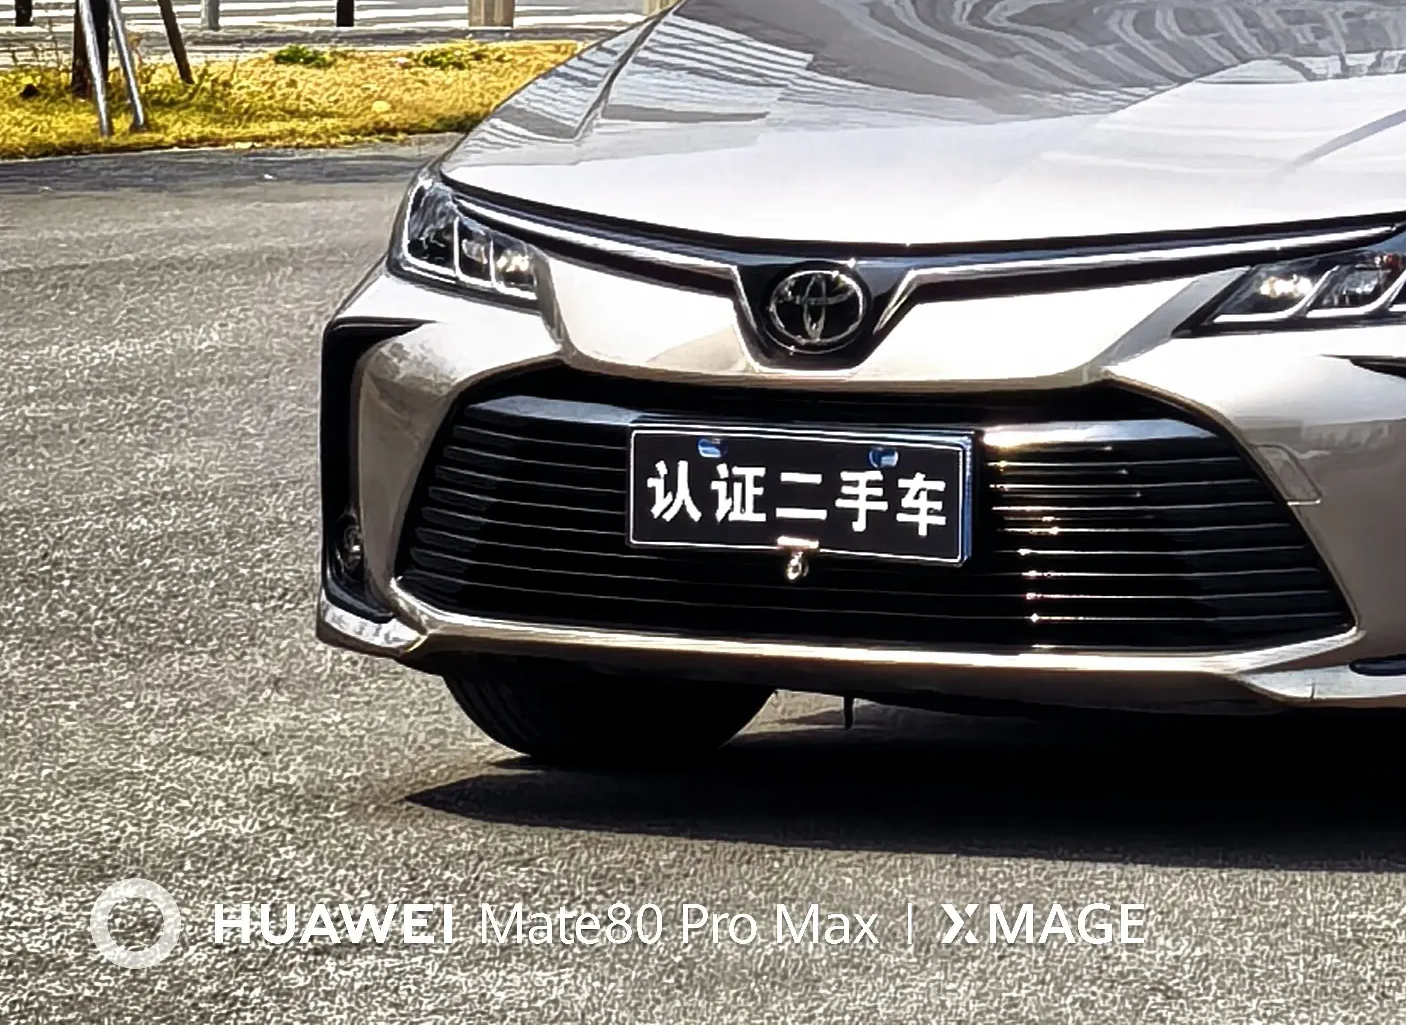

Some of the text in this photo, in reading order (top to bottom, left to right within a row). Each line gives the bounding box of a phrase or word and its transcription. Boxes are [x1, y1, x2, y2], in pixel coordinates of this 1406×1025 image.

[646, 459, 947, 537] 认证二手车
